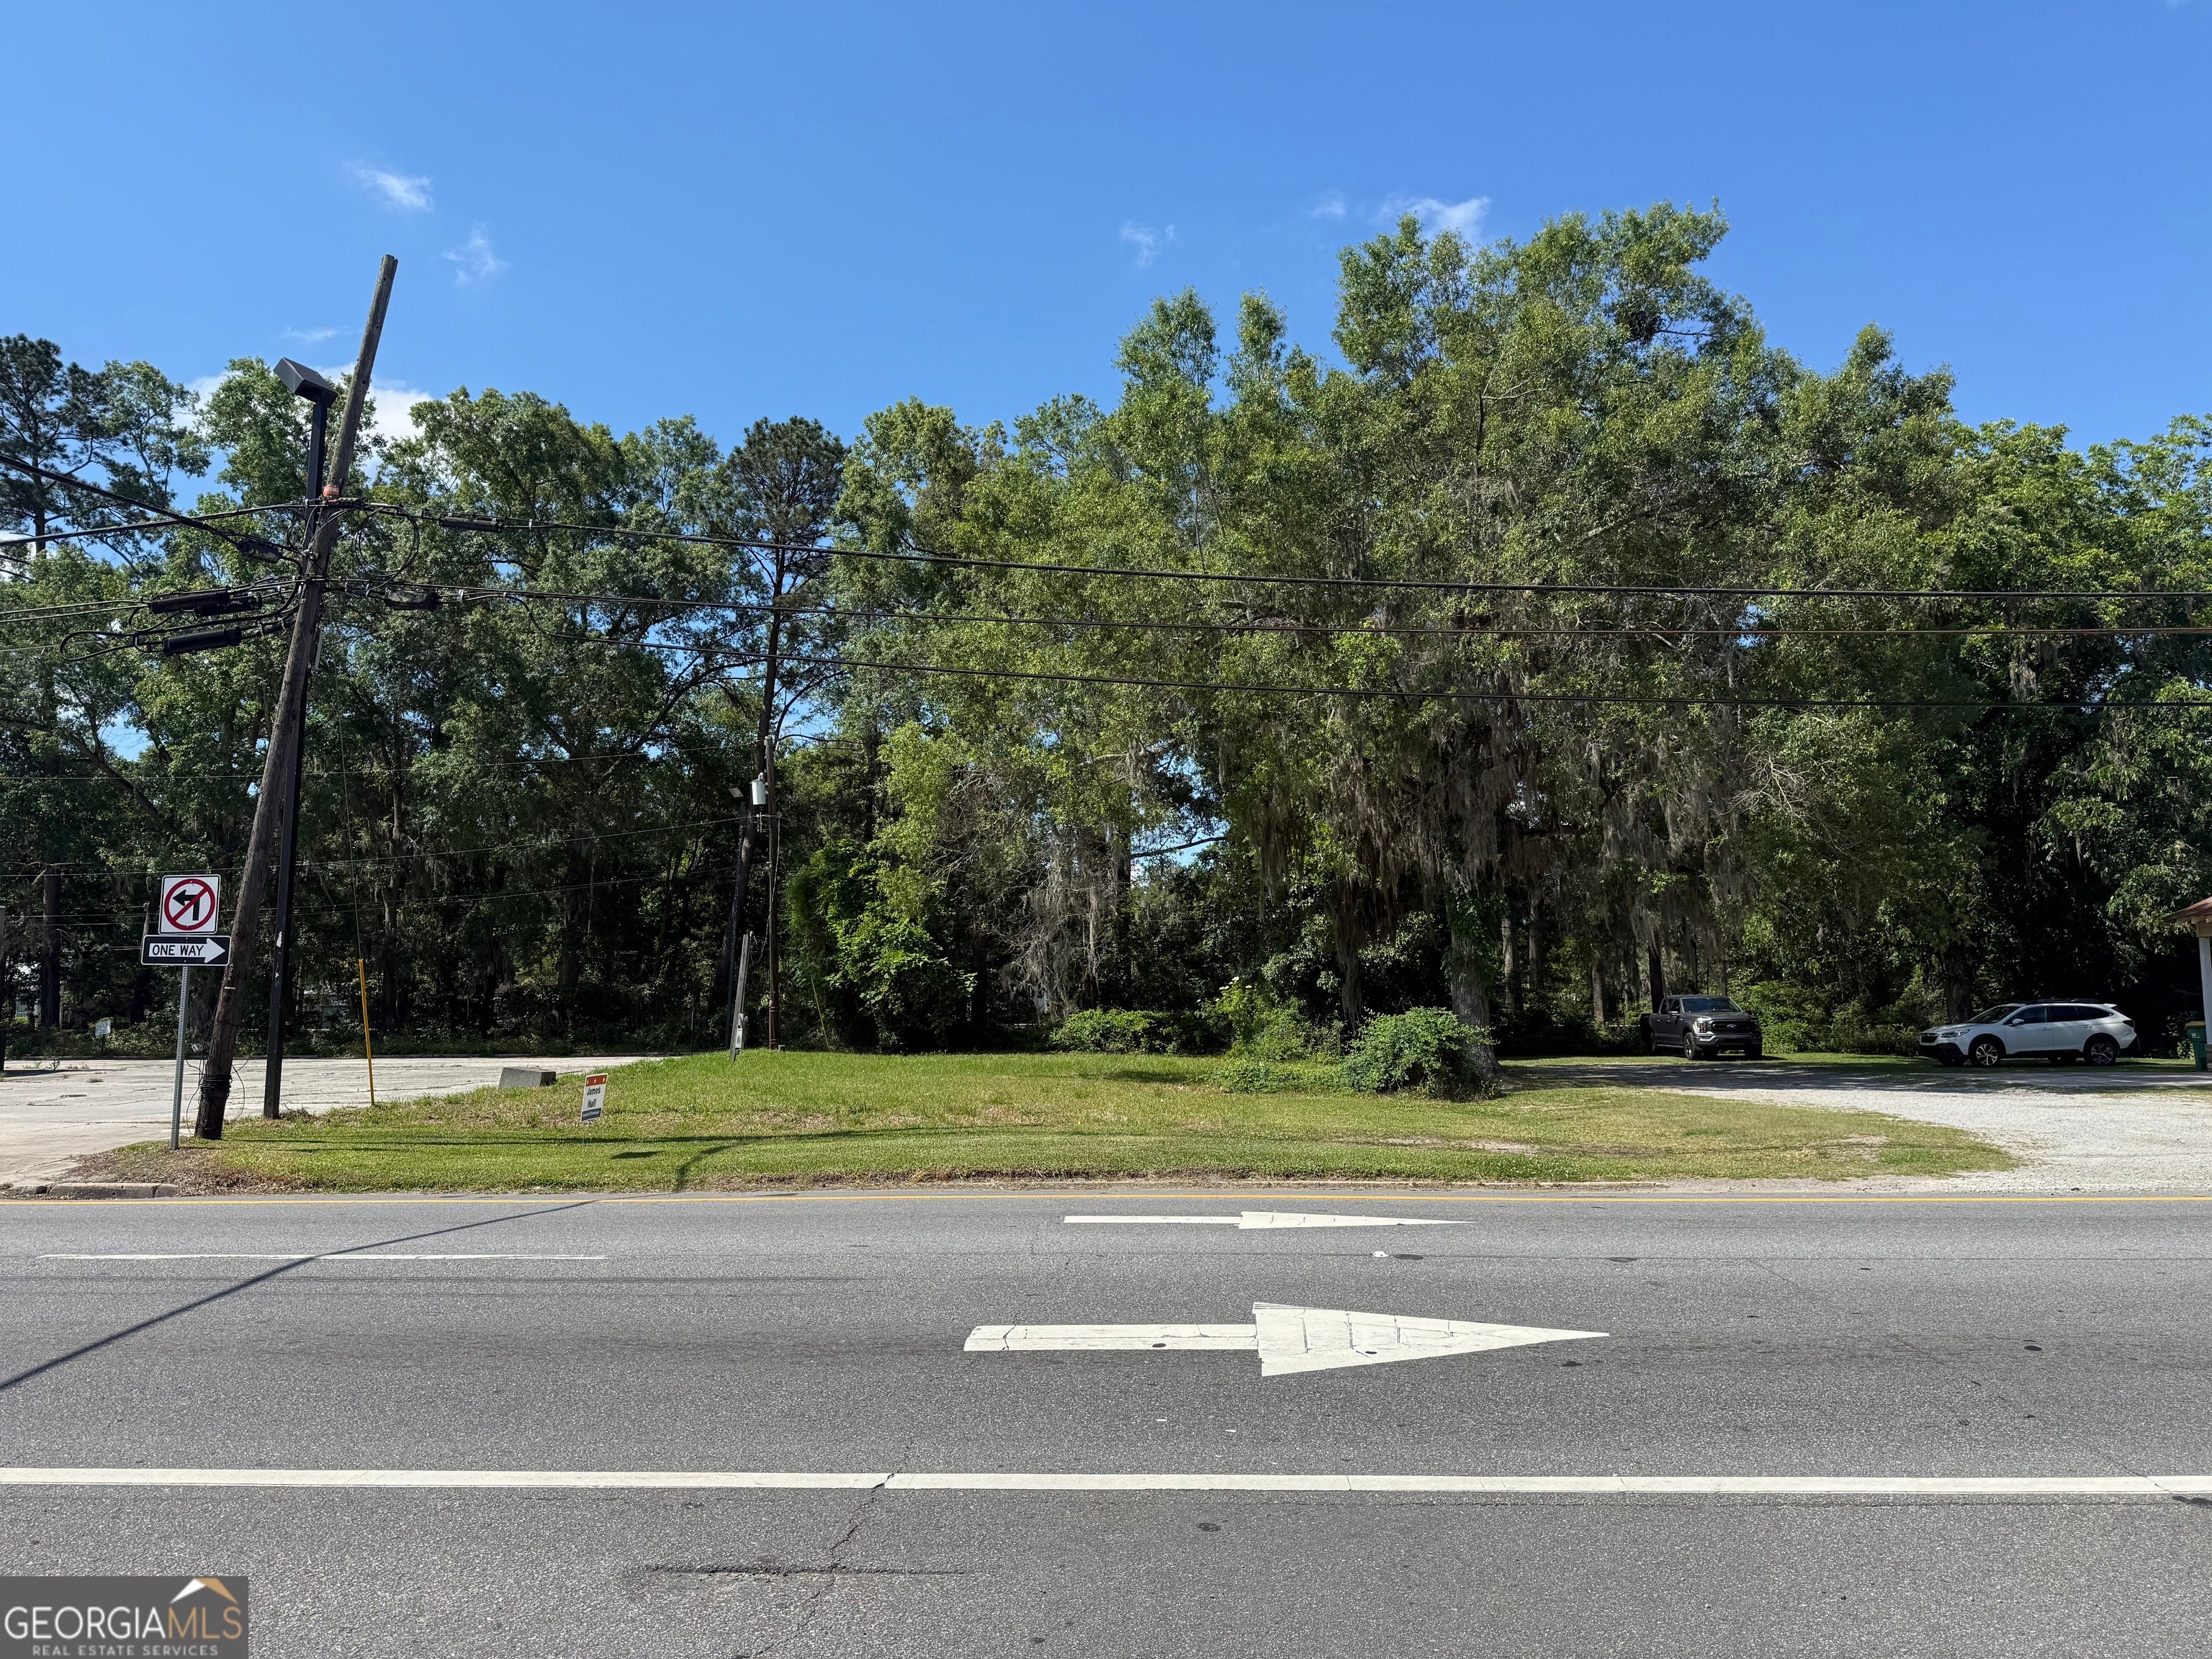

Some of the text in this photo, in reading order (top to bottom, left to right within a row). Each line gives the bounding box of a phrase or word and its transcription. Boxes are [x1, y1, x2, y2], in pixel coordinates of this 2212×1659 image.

[152, 945, 204, 956] ONE WAY
[587, 1087, 601, 1096] James
